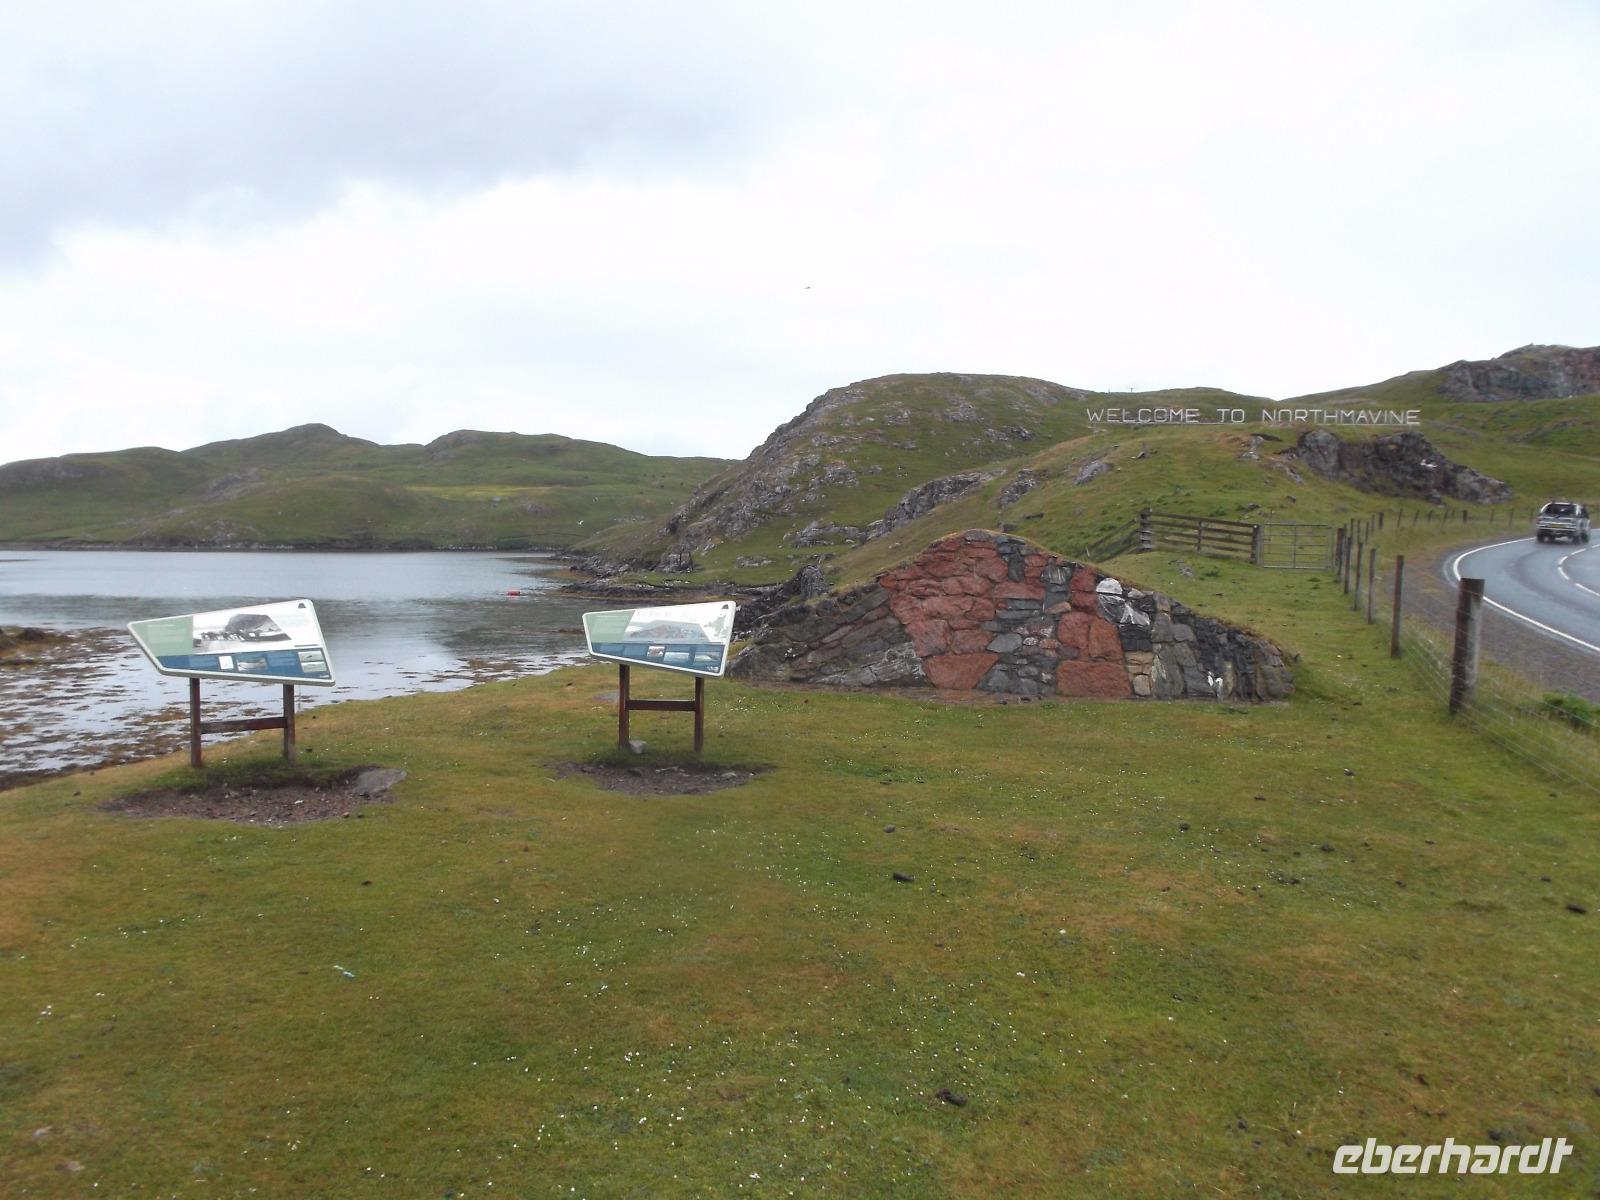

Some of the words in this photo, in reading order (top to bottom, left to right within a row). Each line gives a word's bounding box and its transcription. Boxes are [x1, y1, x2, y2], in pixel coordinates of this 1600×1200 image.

[1087, 407, 1199, 423] WELCOME
[1217, 407, 1245, 424] TO
[1262, 408, 1421, 425] NORTHMAVINE
